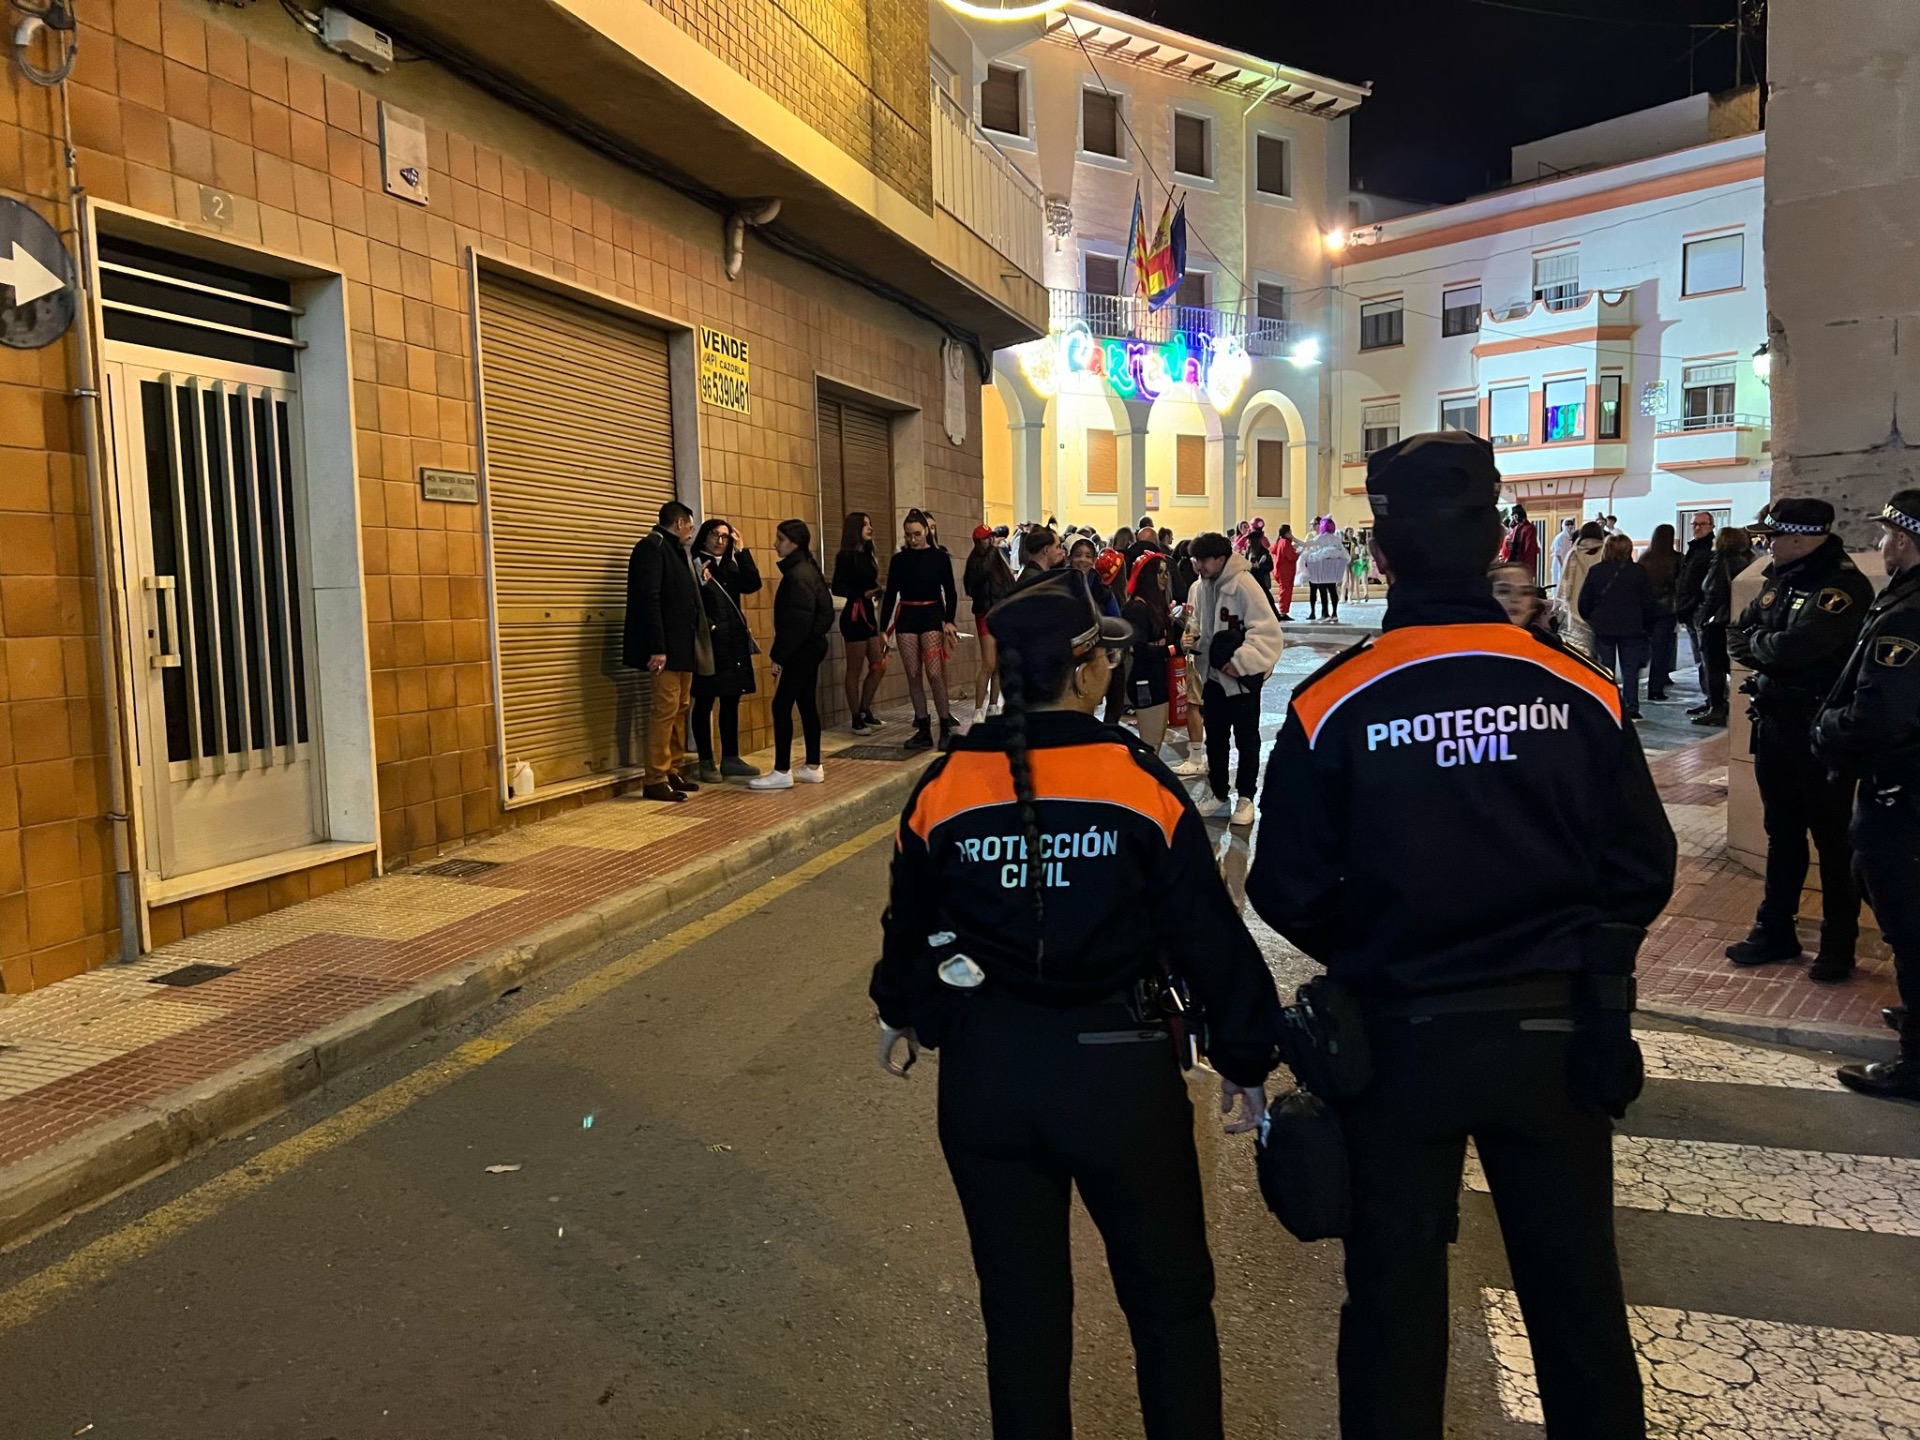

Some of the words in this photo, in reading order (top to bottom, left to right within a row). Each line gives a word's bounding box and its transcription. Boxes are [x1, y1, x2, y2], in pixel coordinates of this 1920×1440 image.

[212, 196, 225, 219] 2
[701, 326, 748, 363] VENDE
[1366, 697, 1570, 751] PROTECCIÓN
[1436, 734, 1517, 768] CIVIL
[1001, 862, 1070, 888] CIIL
